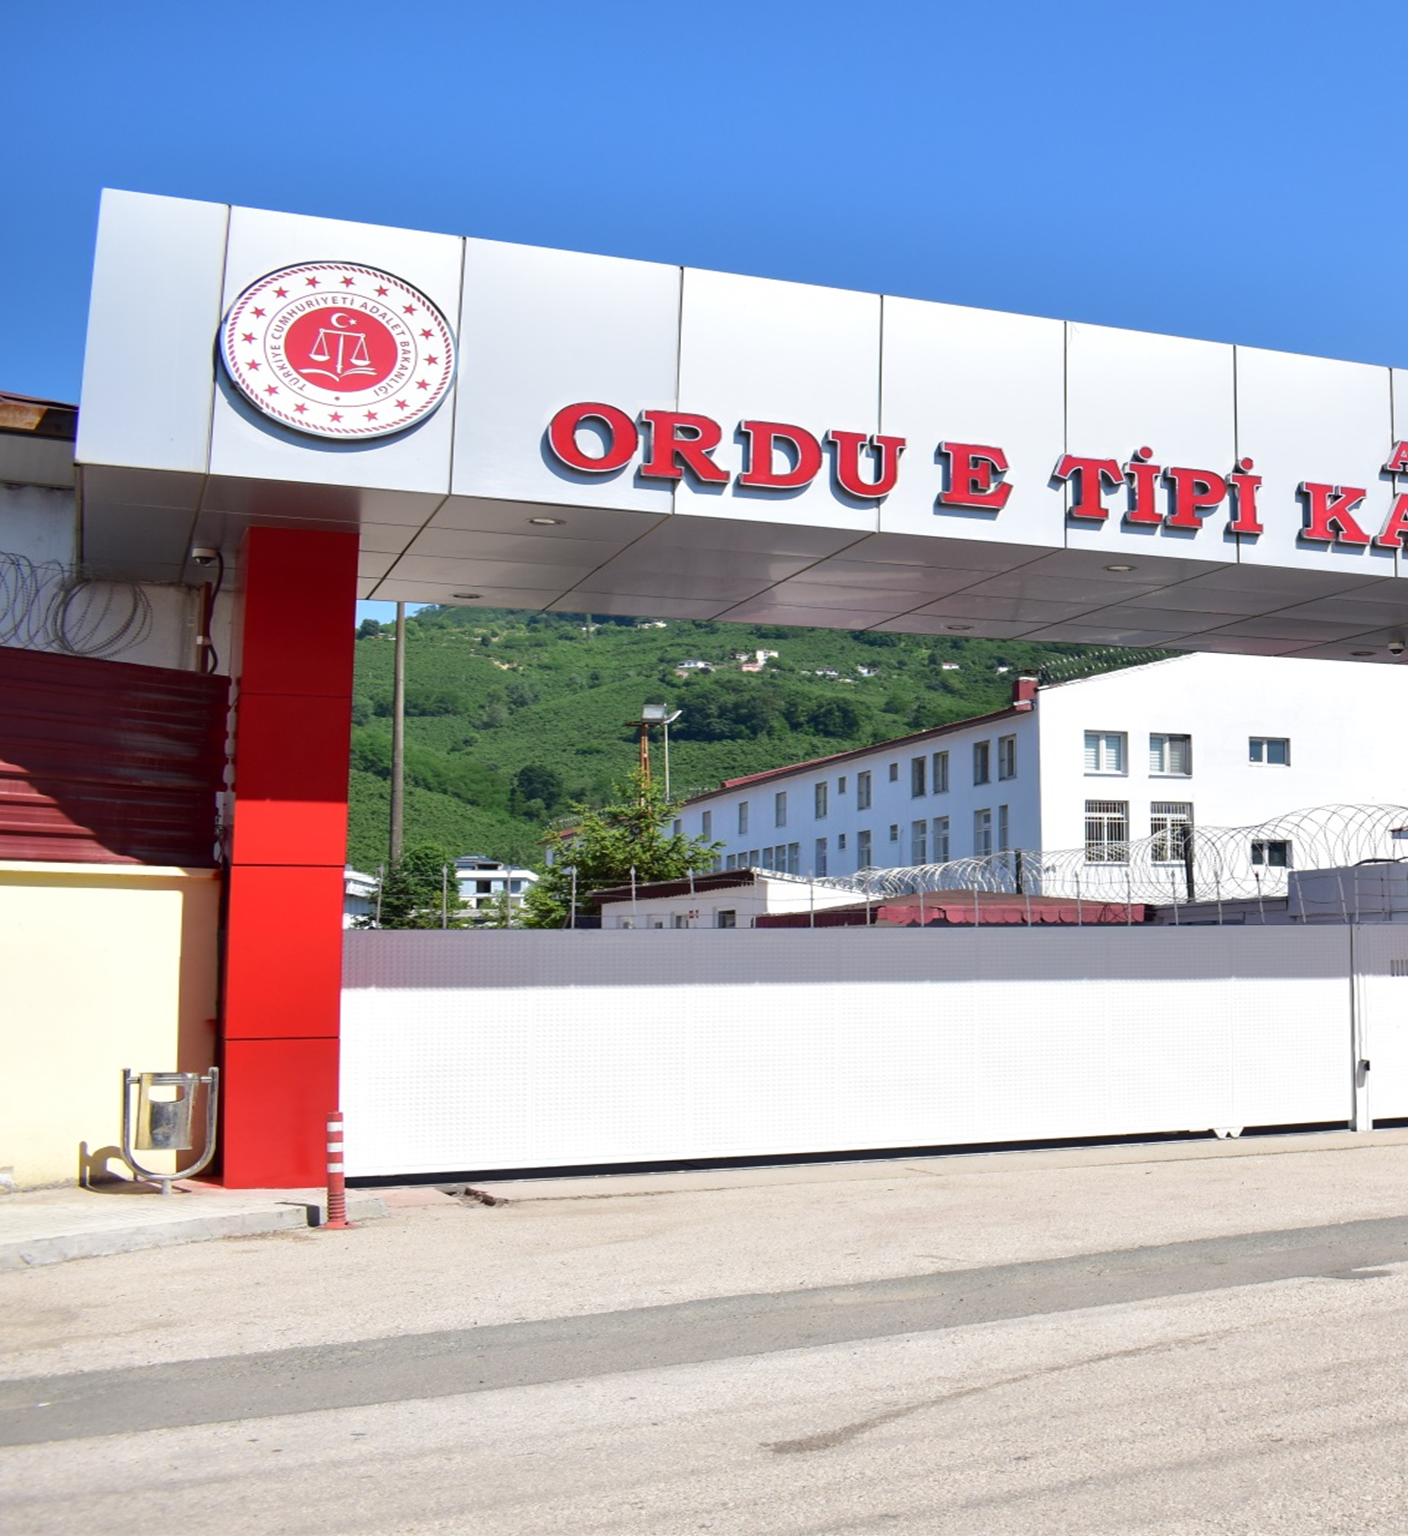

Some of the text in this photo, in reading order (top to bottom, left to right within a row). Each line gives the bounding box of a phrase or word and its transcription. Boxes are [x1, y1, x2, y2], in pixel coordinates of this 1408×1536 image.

[270, 296, 411, 396] TÜRKİYE CUMHURİYETİ ADALET BAKANLIĞI
[548, 402, 906, 497] ORDU
[940, 442, 1012, 509] E
[1056, 446, 1264, 534] TİPİ
